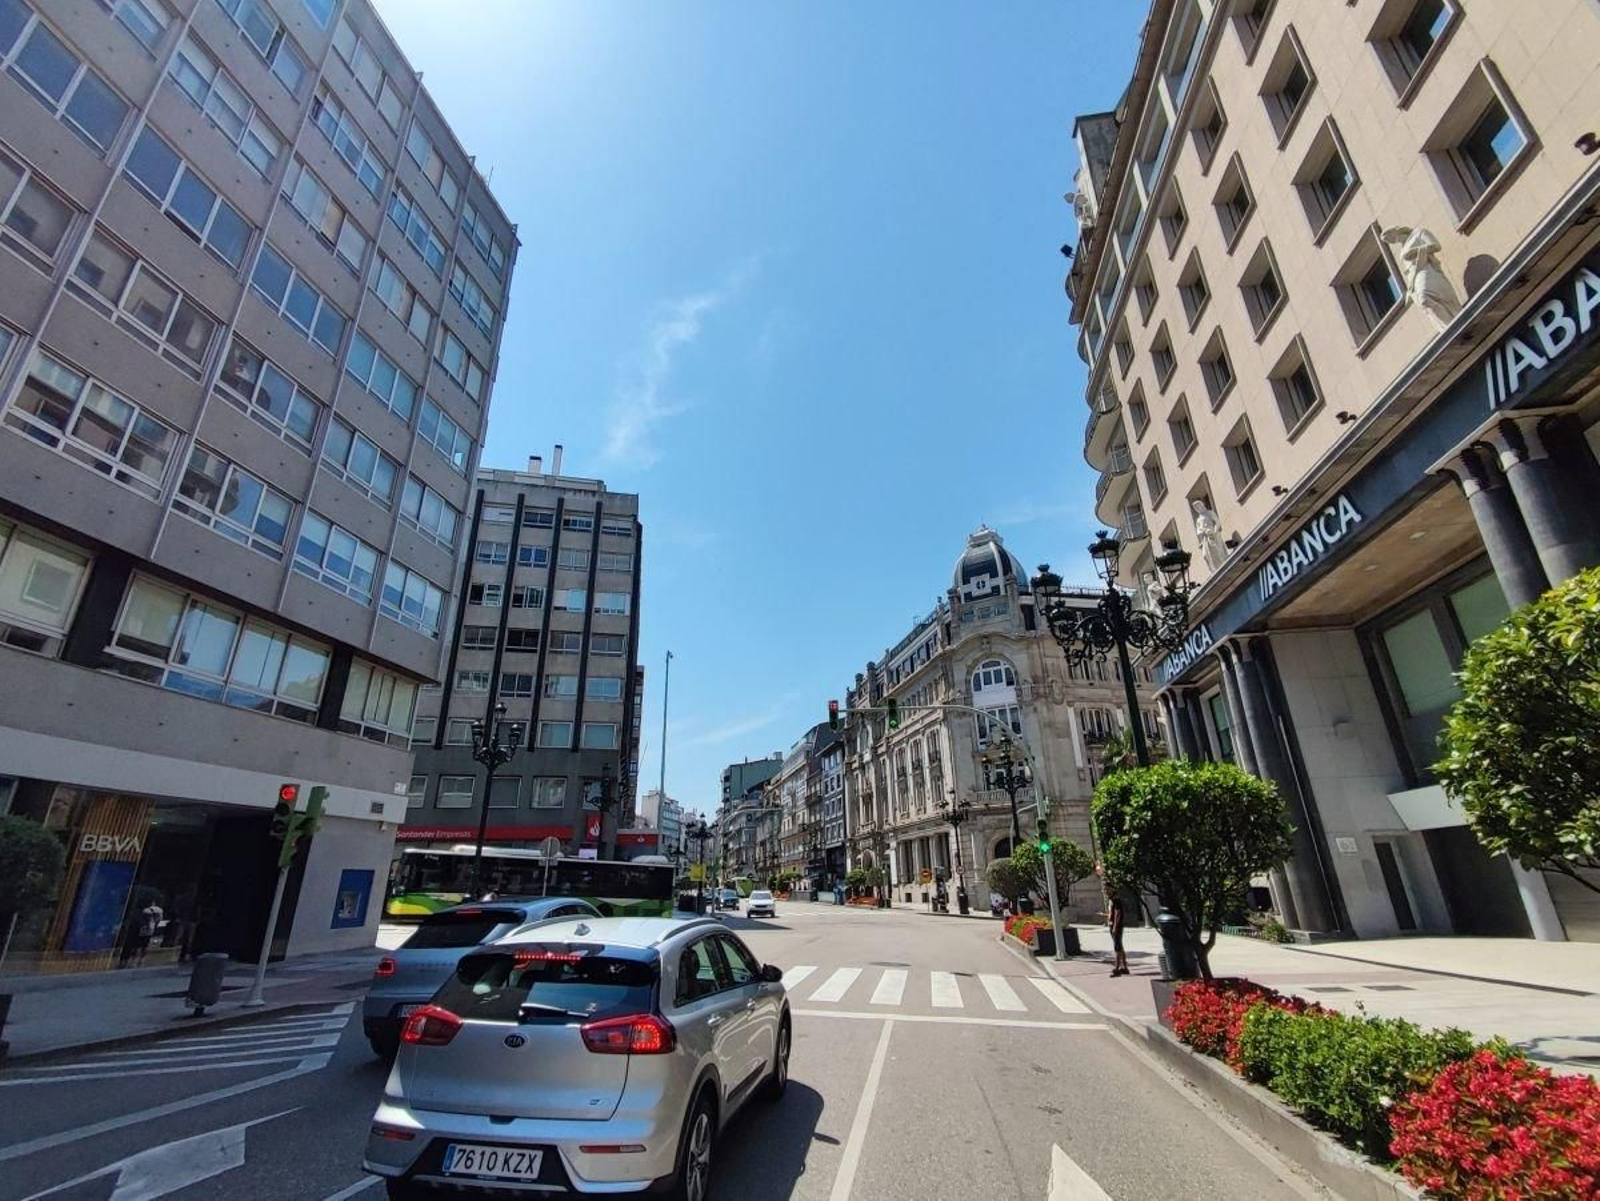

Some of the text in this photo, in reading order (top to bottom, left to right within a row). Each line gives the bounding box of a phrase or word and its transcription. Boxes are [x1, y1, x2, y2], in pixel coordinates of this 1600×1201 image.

[80, 834, 141, 853] BBVA
[396, 830, 472, 839] Santander Empresas
[454, 1148, 538, 1175] 7610 KZX
